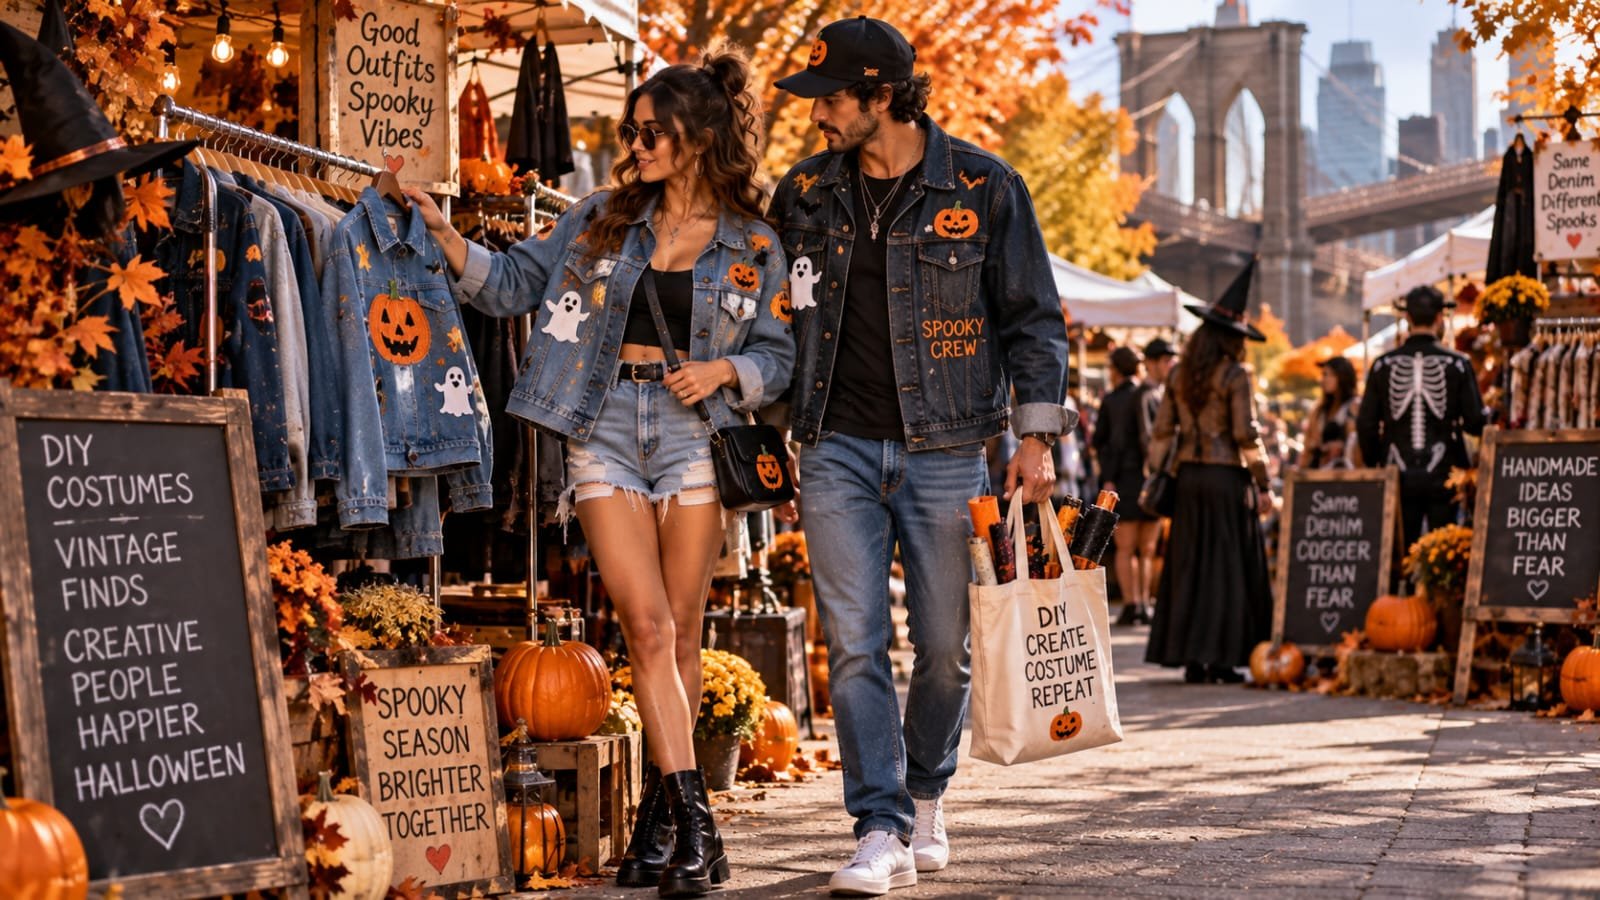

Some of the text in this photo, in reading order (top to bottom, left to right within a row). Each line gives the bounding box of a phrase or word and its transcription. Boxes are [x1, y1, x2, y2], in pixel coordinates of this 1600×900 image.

[361, 12, 420, 47] Good
[346, 45, 435, 87] Outfits
[348, 81, 436, 127] Spooky
[360, 118, 423, 149] Vibes
[1553, 152, 1590, 170] Same
[1548, 173, 1595, 191] Denim
[1546, 211, 1597, 235] Spooks
[922, 317, 985, 338] SPOOKY
[930, 339, 977, 359] CREW
[41, 434, 93, 468] DIY
[1501, 456, 1598, 478] HANDMADE
[47, 473, 194, 509] COSTUMES
[1310, 490, 1359, 514] Same
[1519, 482, 1573, 502] IDEAS
[1506, 507, 1581, 529] BIGGER
[55, 532, 182, 569] VINTAGE
[1515, 532, 1567, 551] THAN
[1308, 564, 1357, 583] THAN
[1512, 556, 1565, 577] FEAR
[61, 574, 148, 611] FINDS
[1305, 587, 1354, 609] FEAR
[1038, 602, 1067, 628] DIY
[64, 620, 203, 663] CREATIVE
[1026, 625, 1087, 656] CREATE
[1025, 650, 1097, 682] COSTUME
[71, 663, 182, 707] PEOPLE
[1032, 676, 1094, 709] REPEAT
[377, 684, 466, 720] SPOOKY
[77, 703, 205, 751] HAPPIER
[383, 725, 470, 760] SEASON
[74, 742, 246, 802] HALLOWEEN
[378, 764, 485, 801] BRIGHTER
[381, 803, 490, 840] TOGETHER
